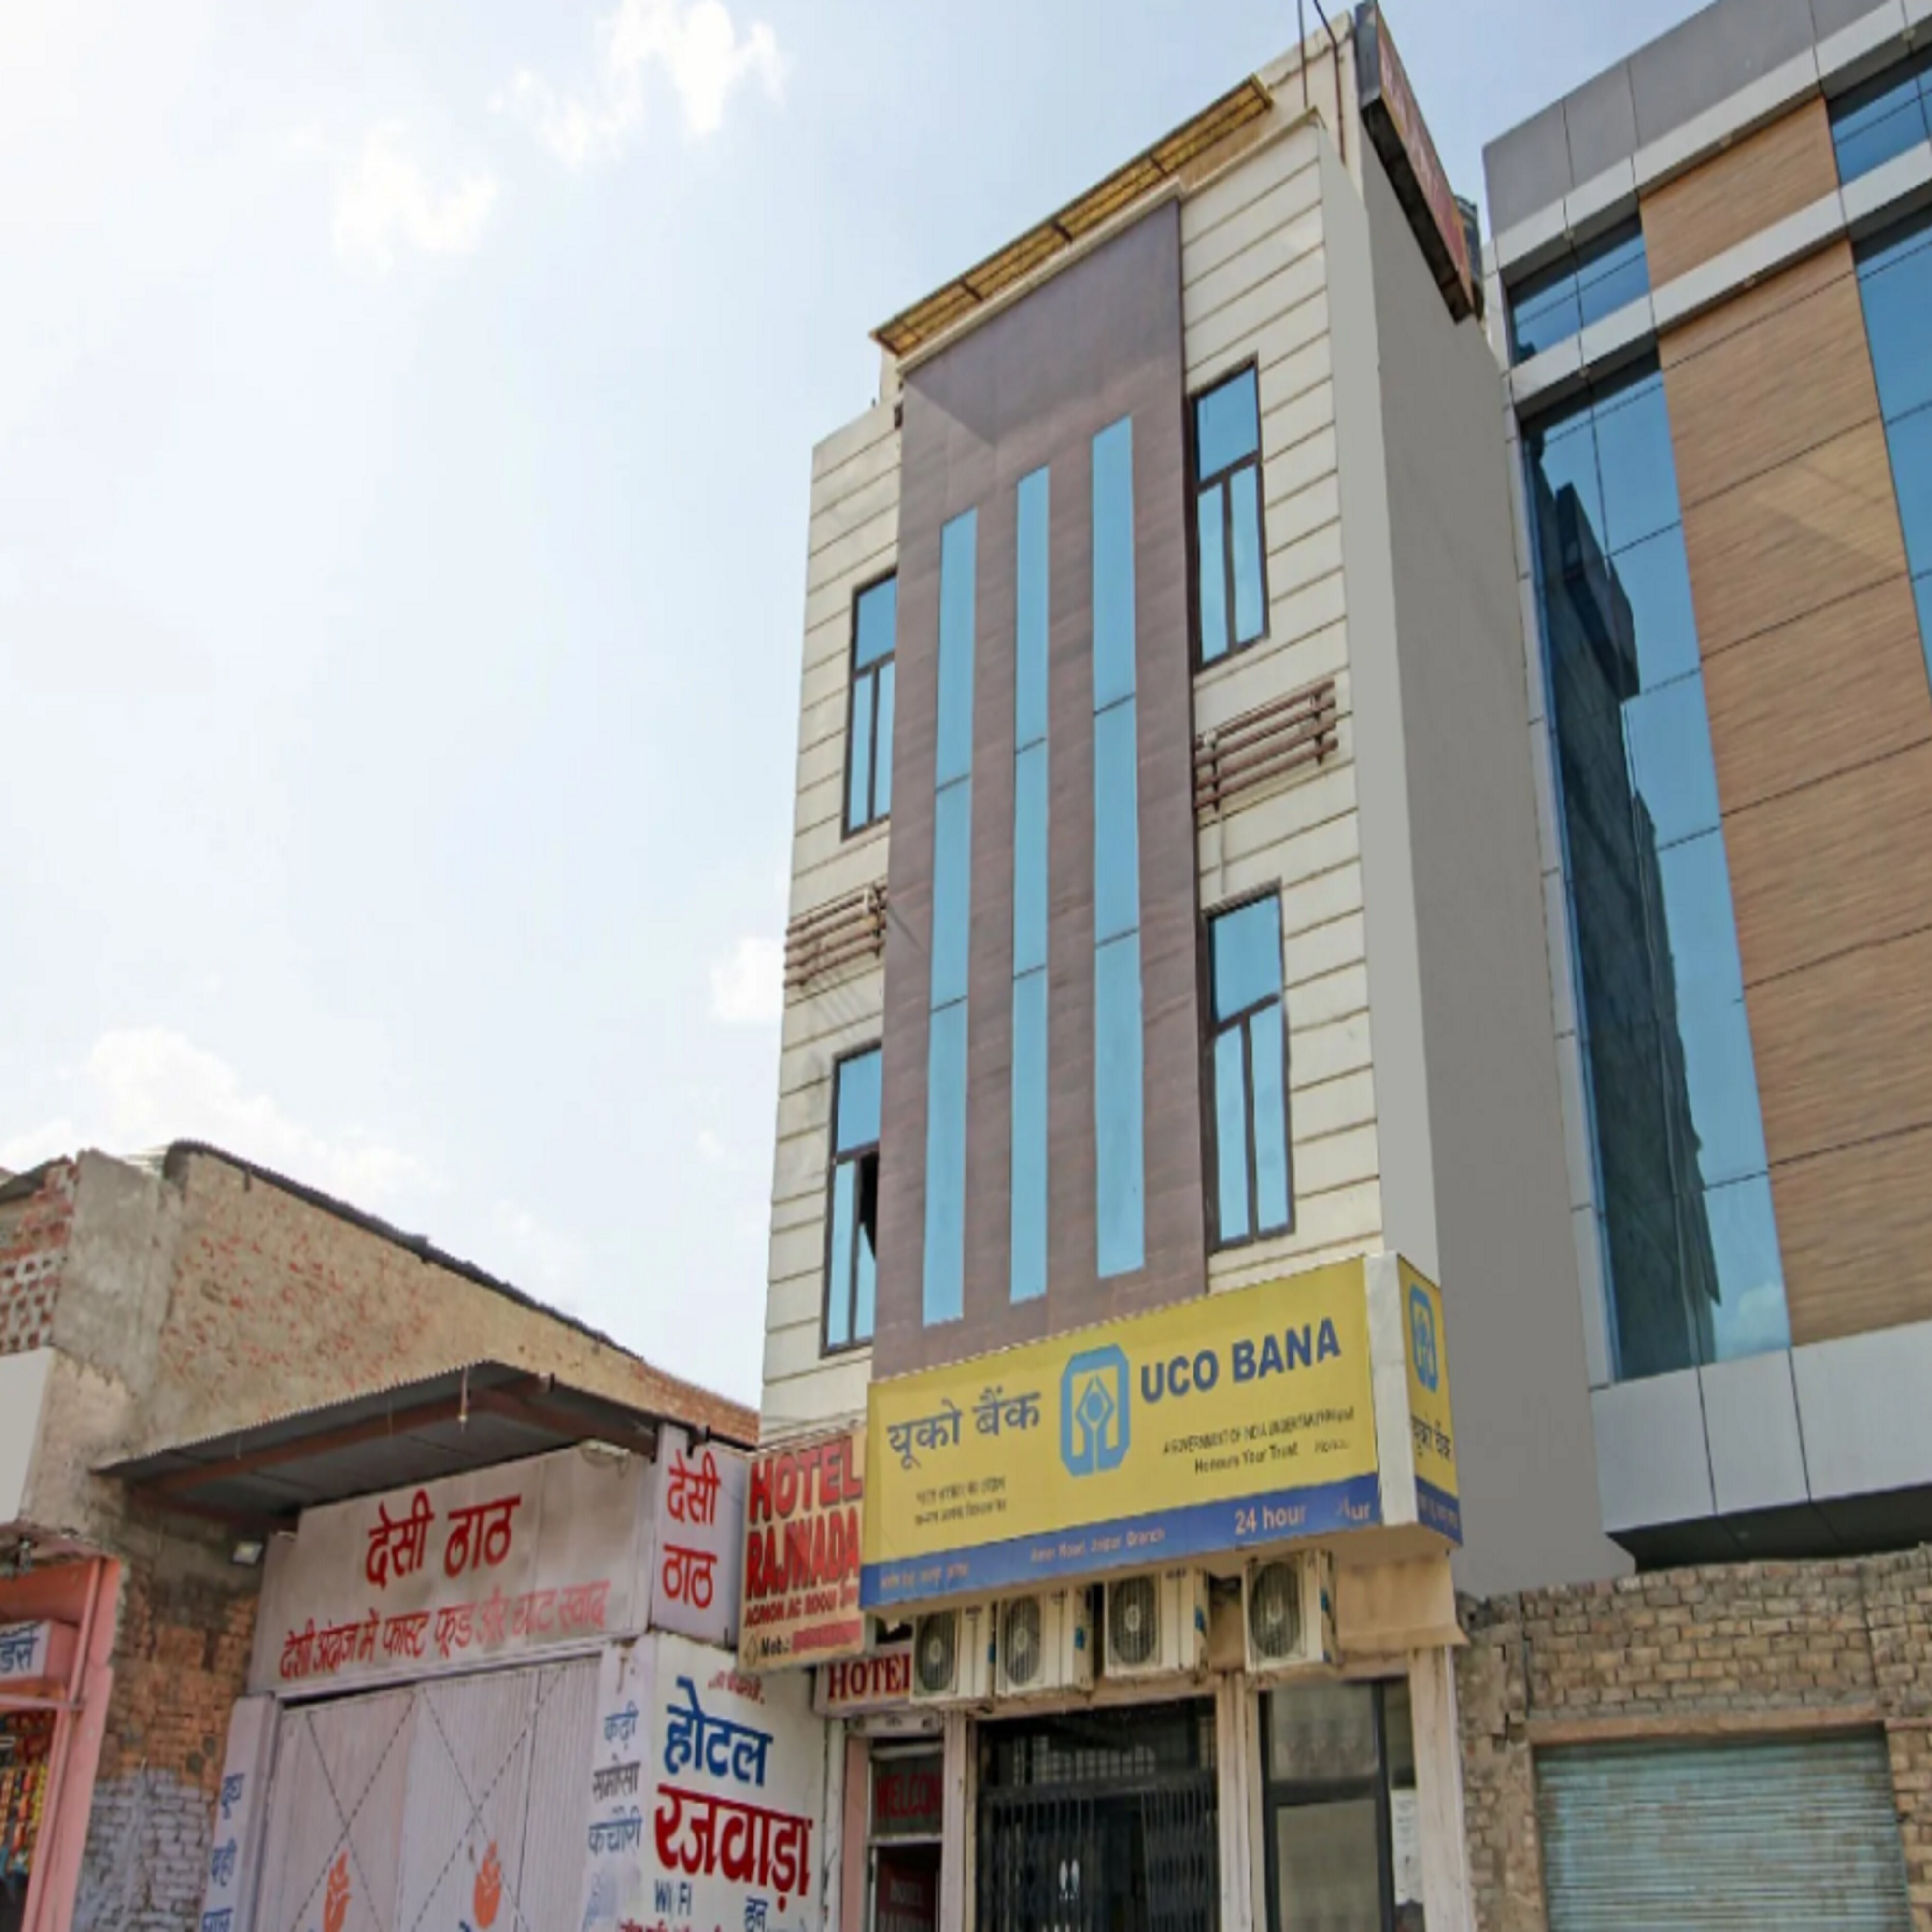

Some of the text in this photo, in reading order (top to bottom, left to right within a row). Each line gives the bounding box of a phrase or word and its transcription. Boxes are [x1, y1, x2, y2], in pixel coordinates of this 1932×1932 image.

[1141, 1350, 1219, 1403] UCO
[887, 1385, 1041, 1469] यूको बैंक
[667, 1451, 721, 1526] देसी
[750, 1435, 863, 1525] HOTEL
[1235, 1506, 1256, 1535] 24
[366, 1489, 522, 1590] देसी ठाठ
[663, 1544, 717, 1609] ठाठ
[746, 1506, 859, 1602] RAJWADA
[664, 1676, 774, 1787] होटल
[655, 1784, 813, 1913] रजवाड़ा
